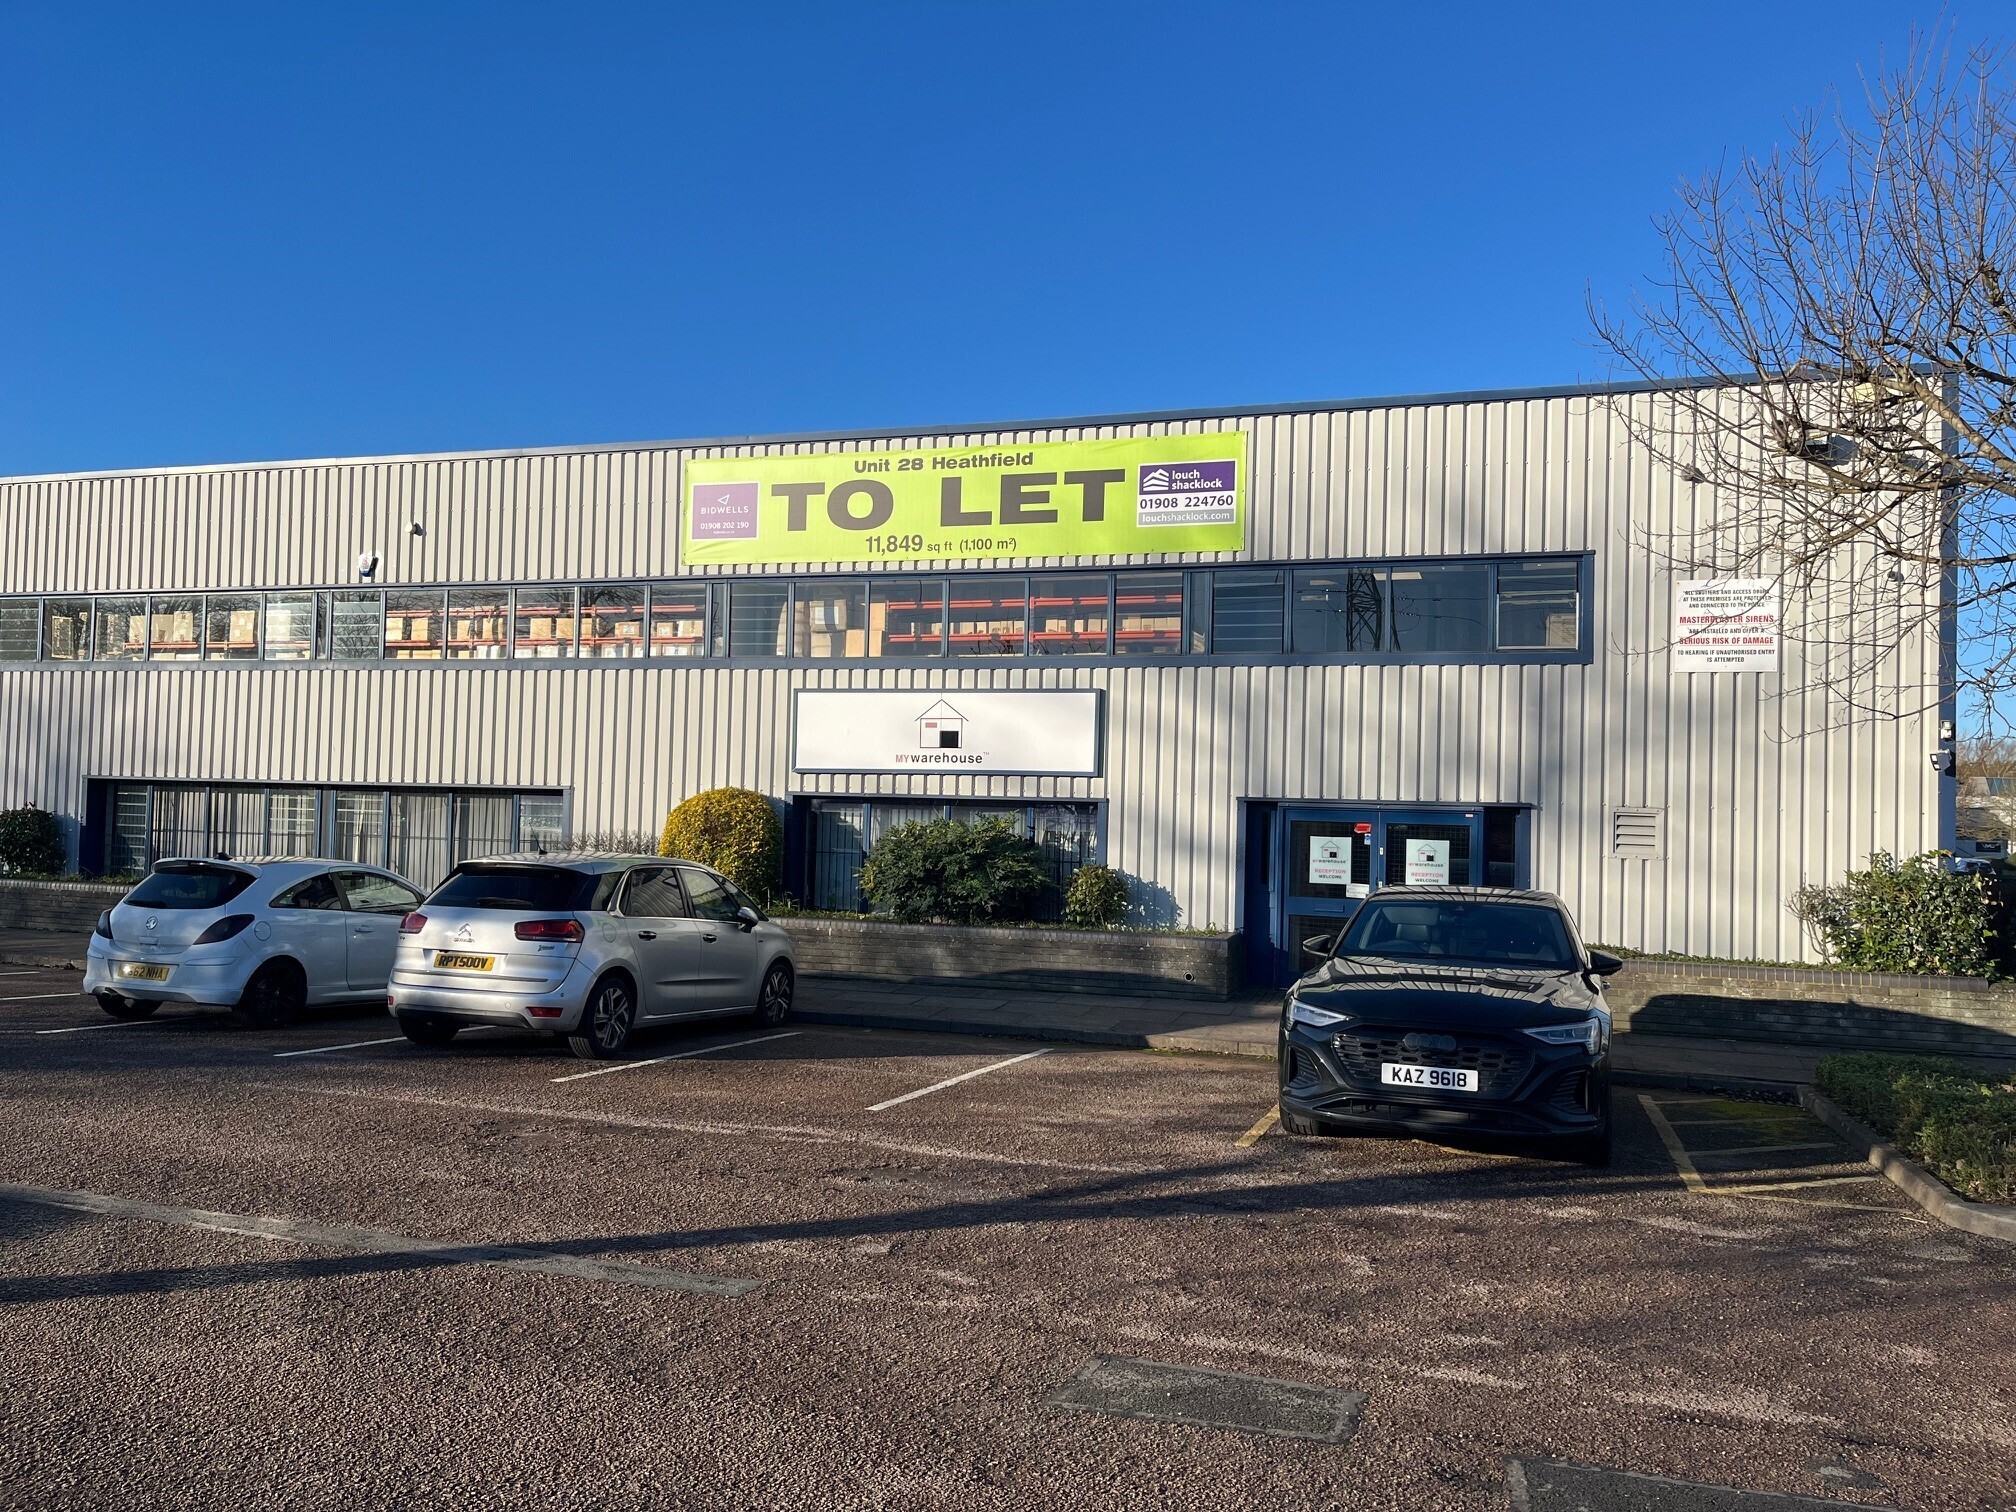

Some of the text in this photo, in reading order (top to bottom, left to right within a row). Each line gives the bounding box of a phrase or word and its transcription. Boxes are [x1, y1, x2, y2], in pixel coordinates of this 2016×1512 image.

[854, 452, 1034, 473] Unit 28 Heathfield
[1171, 469, 1200, 479] louch
[1171, 478, 1223, 490] shacklock
[771, 468, 1126, 531] TO LET
[1139, 495, 1234, 509] 01908 224760
[700, 506, 749, 515] BIDWELLS
[1142, 511, 1230, 523] louchshacklock.com
[700, 522, 721, 530] 01908
[736, 521, 750, 529] 190
[865, 534, 923, 555] 11,849
[927, 543, 941, 553] sq
[944, 541, 952, 551] ft
[959, 538, 993, 552] (1,100
[1746, 615, 1774, 623] SIRENS
[1680, 637, 1710, 645] SERIOUS
[1712, 637, 1730, 645] RISK
[1392, 1067, 1467, 1087] KAZ 9618
